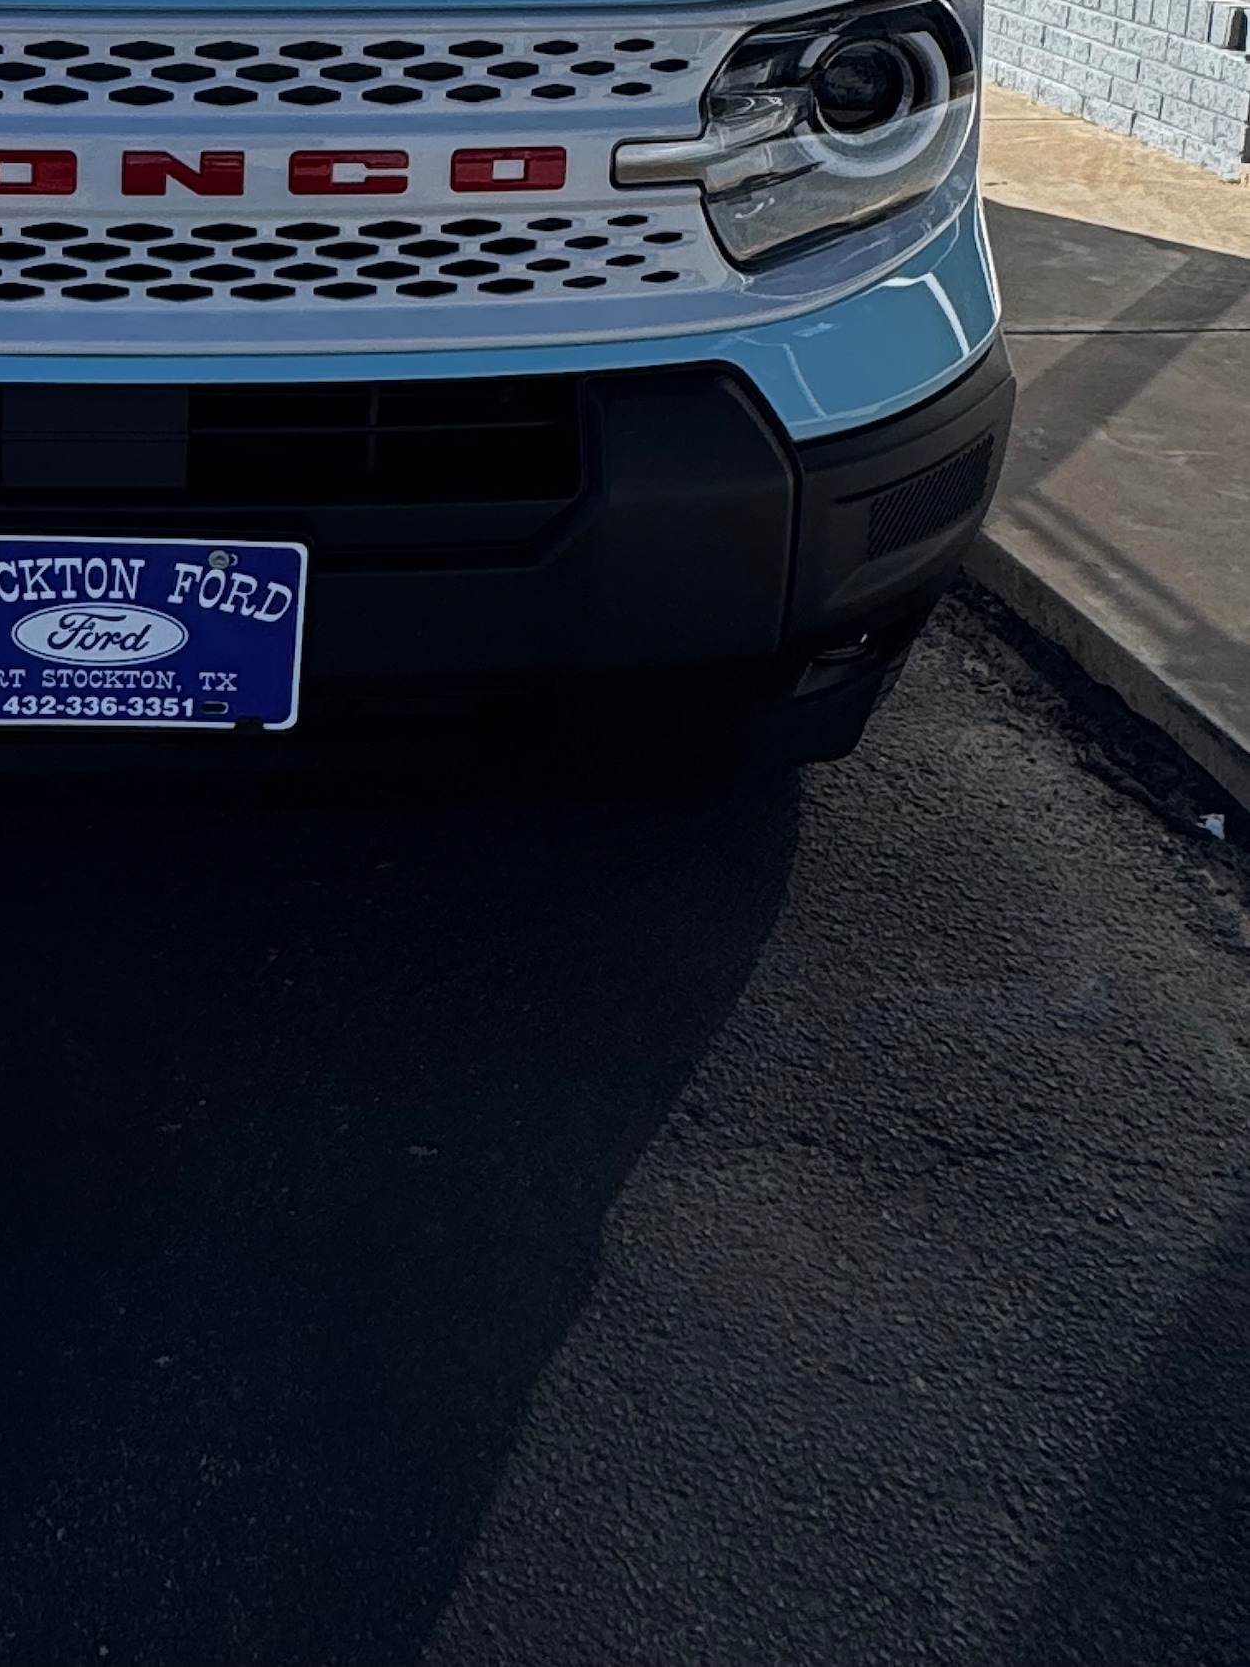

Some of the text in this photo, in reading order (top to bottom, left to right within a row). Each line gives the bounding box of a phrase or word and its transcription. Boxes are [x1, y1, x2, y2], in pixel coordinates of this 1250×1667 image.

[167, 563, 292, 622] FORD
[47, 613, 151, 652] Ford
[41, 670, 182, 693] STOCKTON,
[199, 672, 238, 692] TX
[2, 696, 194, 717] 432-336-3351
